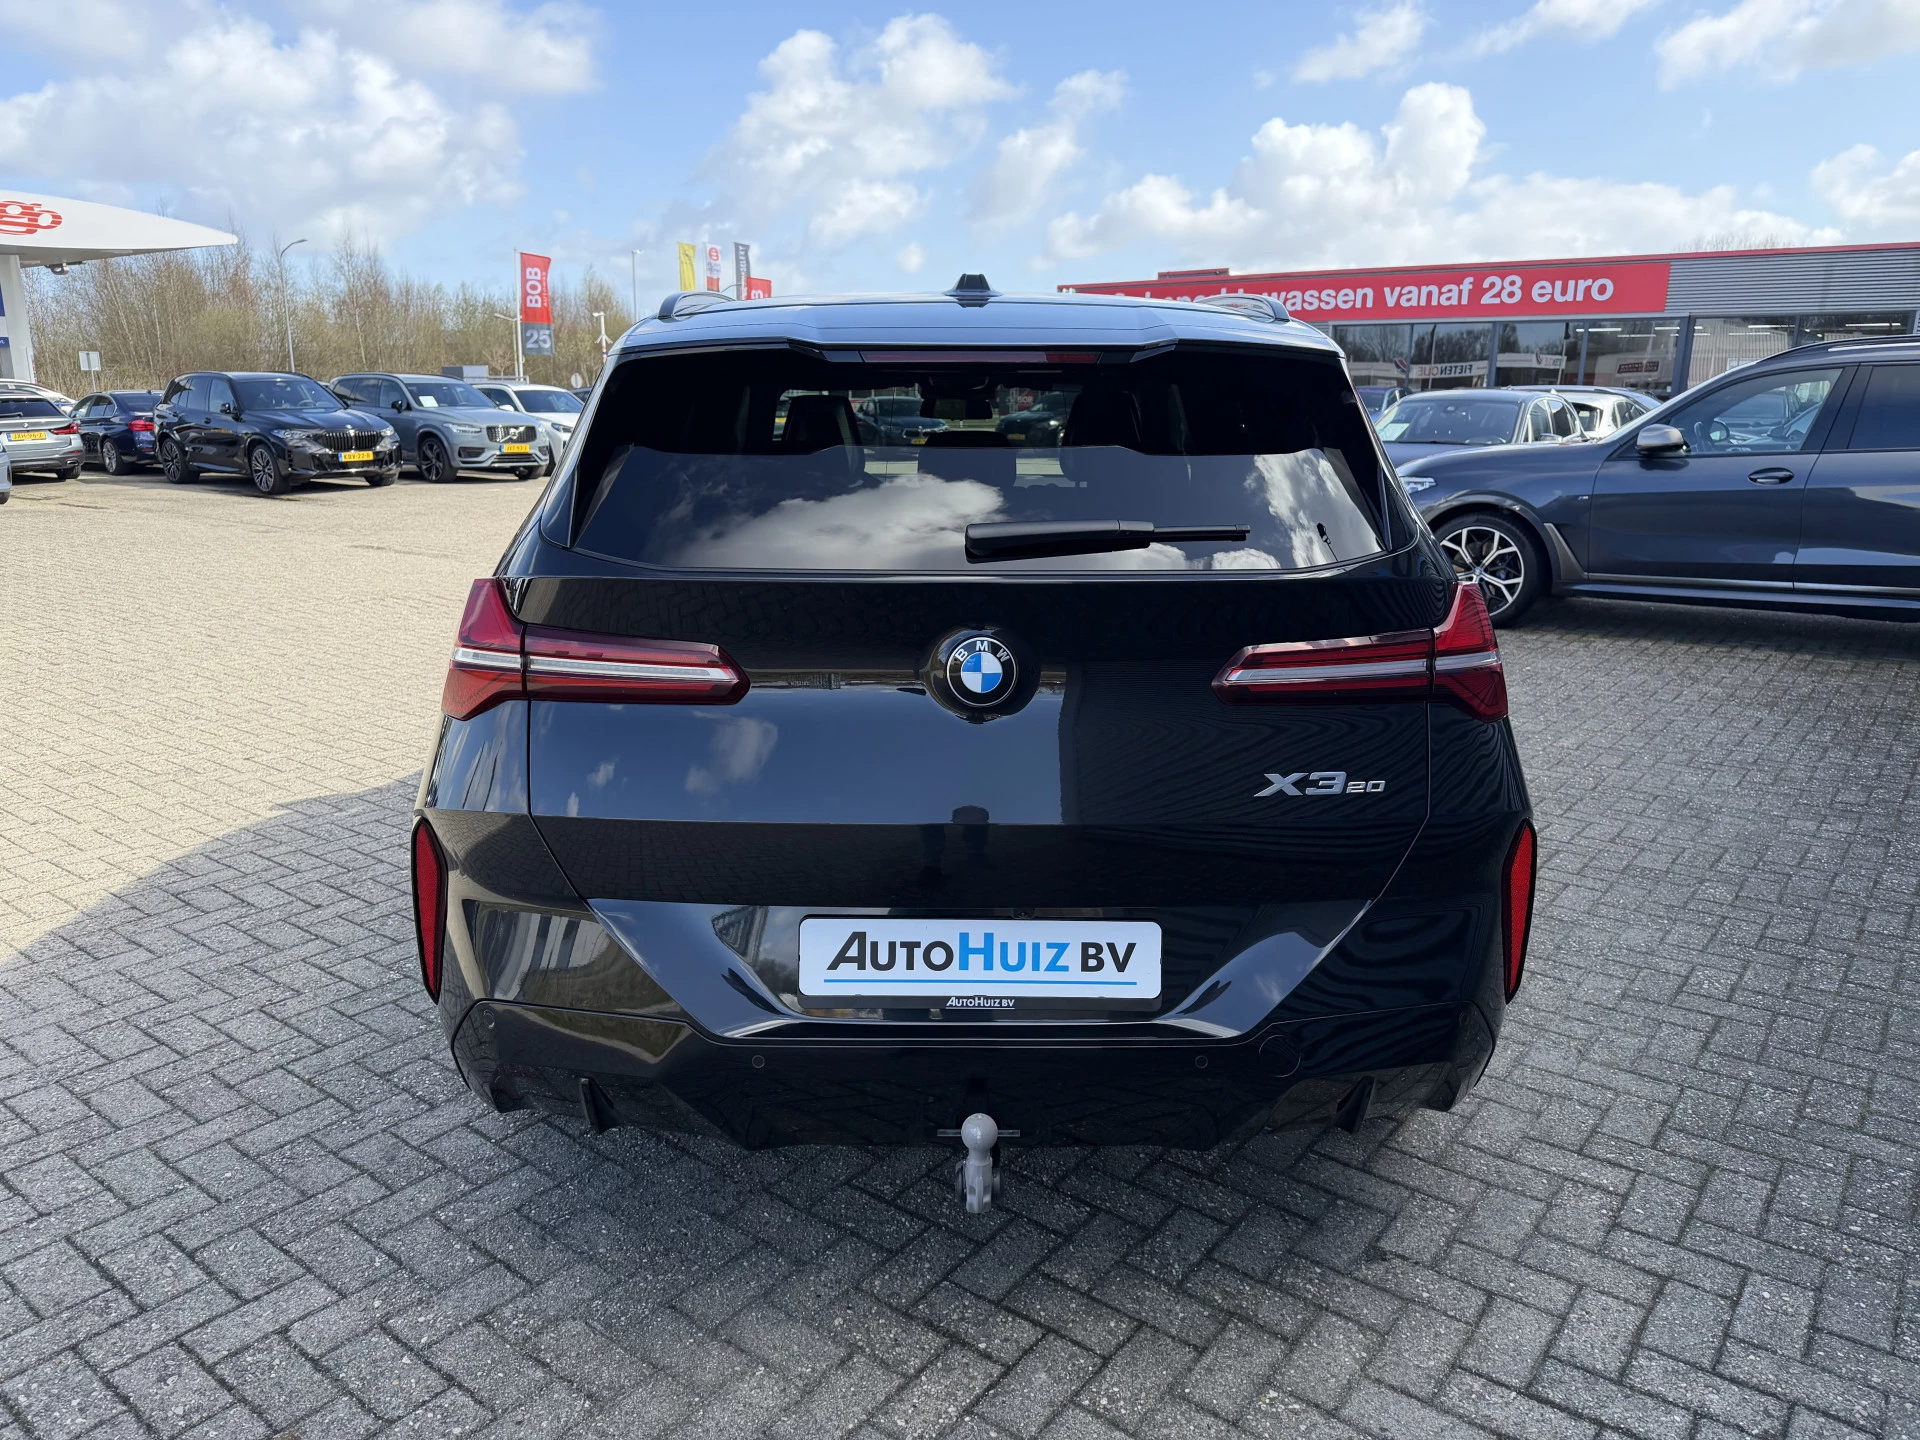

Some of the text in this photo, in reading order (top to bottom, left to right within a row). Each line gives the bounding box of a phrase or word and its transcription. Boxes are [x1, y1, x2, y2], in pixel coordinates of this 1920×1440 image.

[526, 267, 541, 308] BOB
[1384, 277, 1474, 307] vanaf
[1480, 275, 1522, 304] 28
[1531, 277, 1614, 303] euro
[526, 329, 551, 349] 25
[954, 640, 1011, 663] BMW
[1253, 771, 1386, 797] X3 20
[1080, 942, 1138, 973] BV
[1001, 998, 1015, 1007] BV
